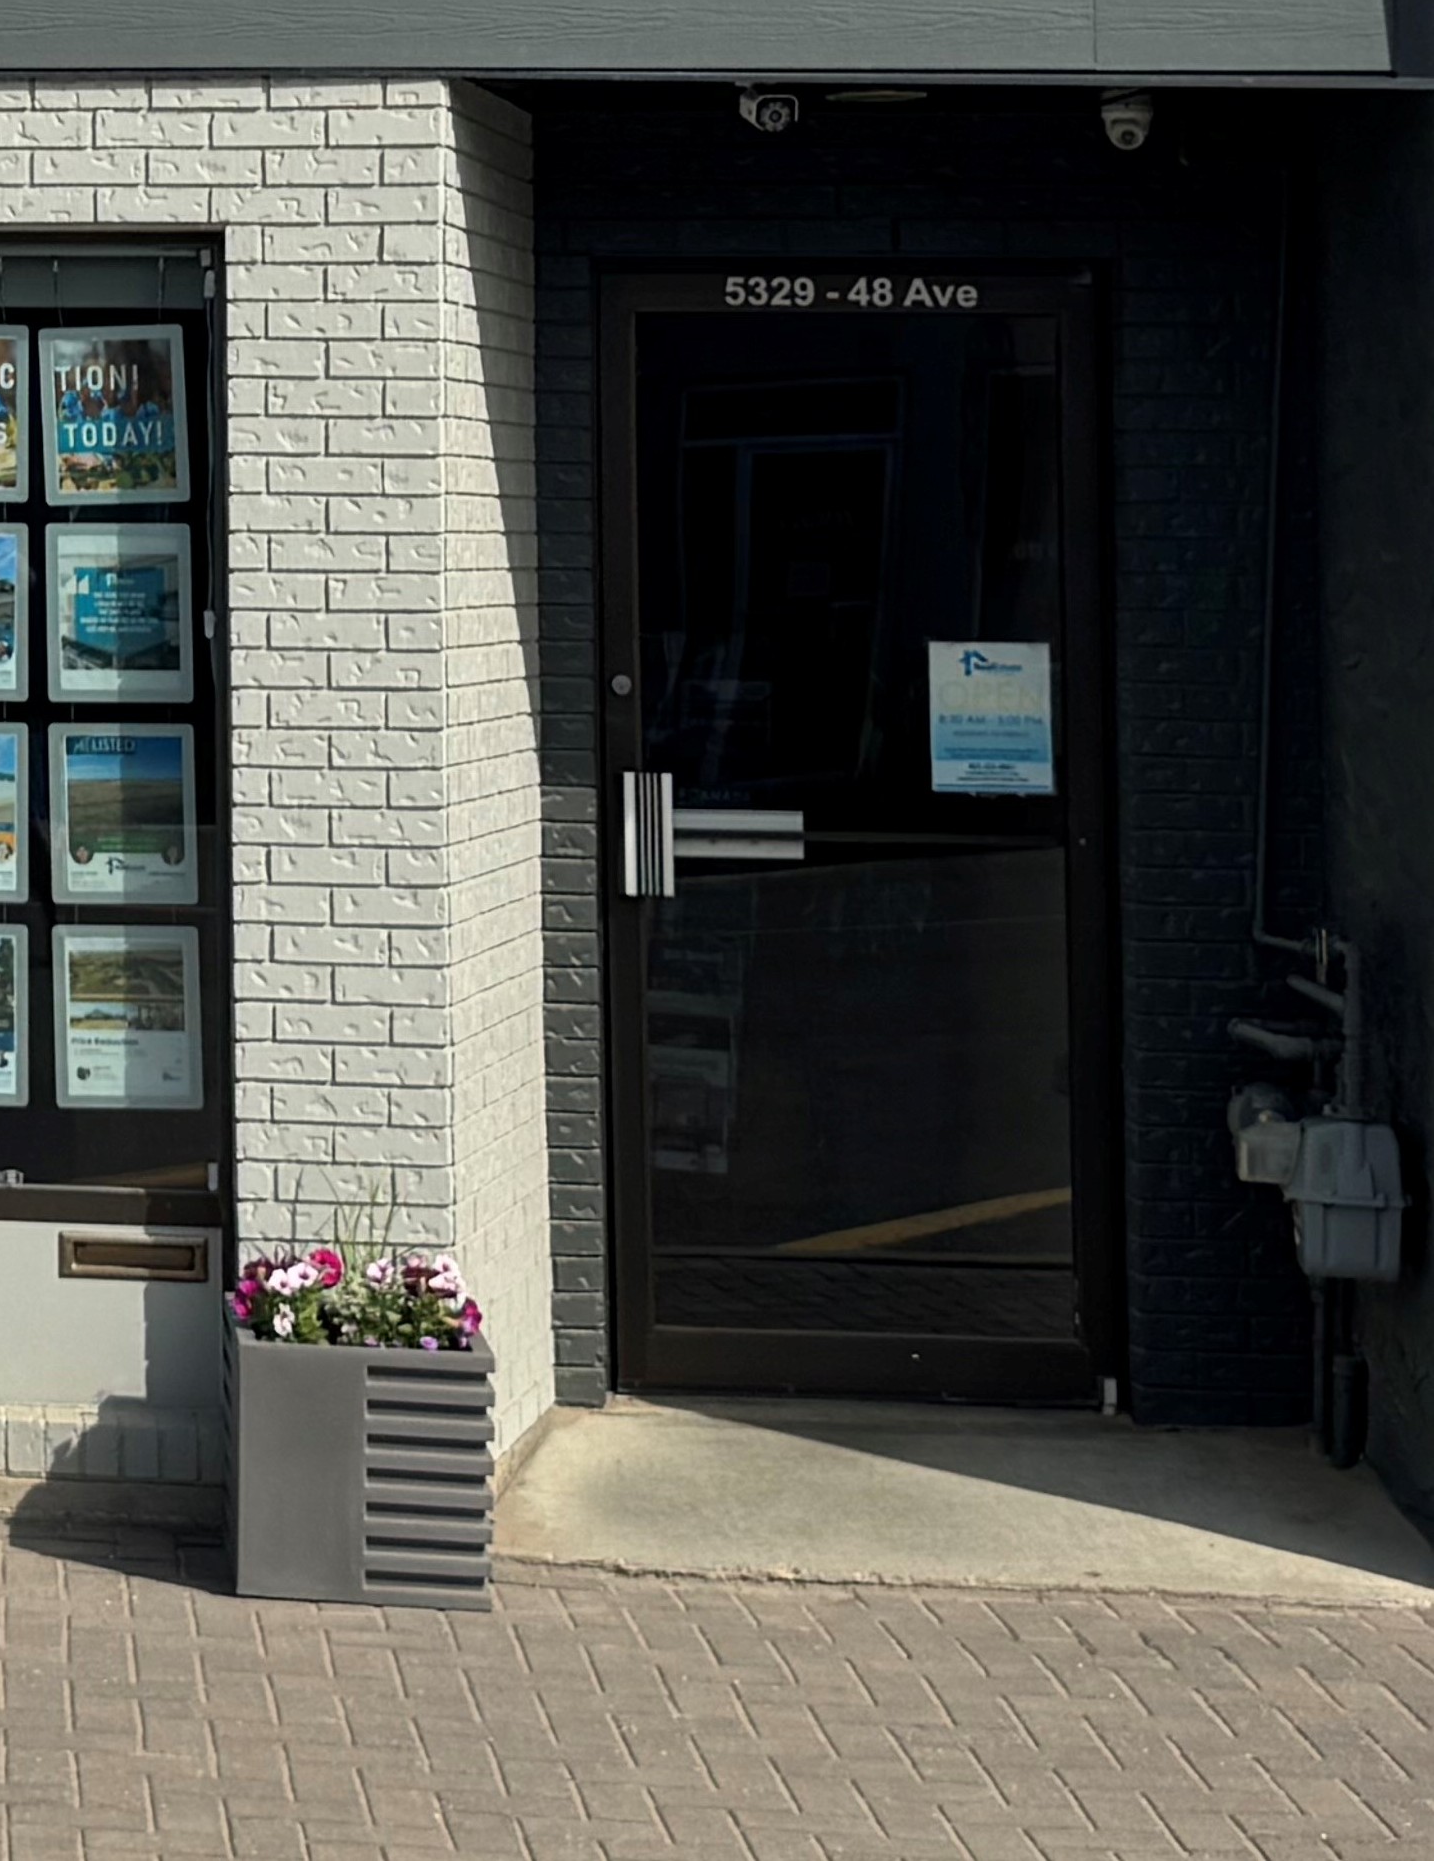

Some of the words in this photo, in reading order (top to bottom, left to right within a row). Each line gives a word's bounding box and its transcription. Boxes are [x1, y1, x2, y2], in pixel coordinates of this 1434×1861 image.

[725, 276, 816, 307] 5329
[847, 277, 893, 307] 48
[902, 277, 978, 308] Ave
[54, 364, 138, 392] TION!
[63, 420, 163, 448] TODAY!
[90, 737, 135, 752] LISTED
